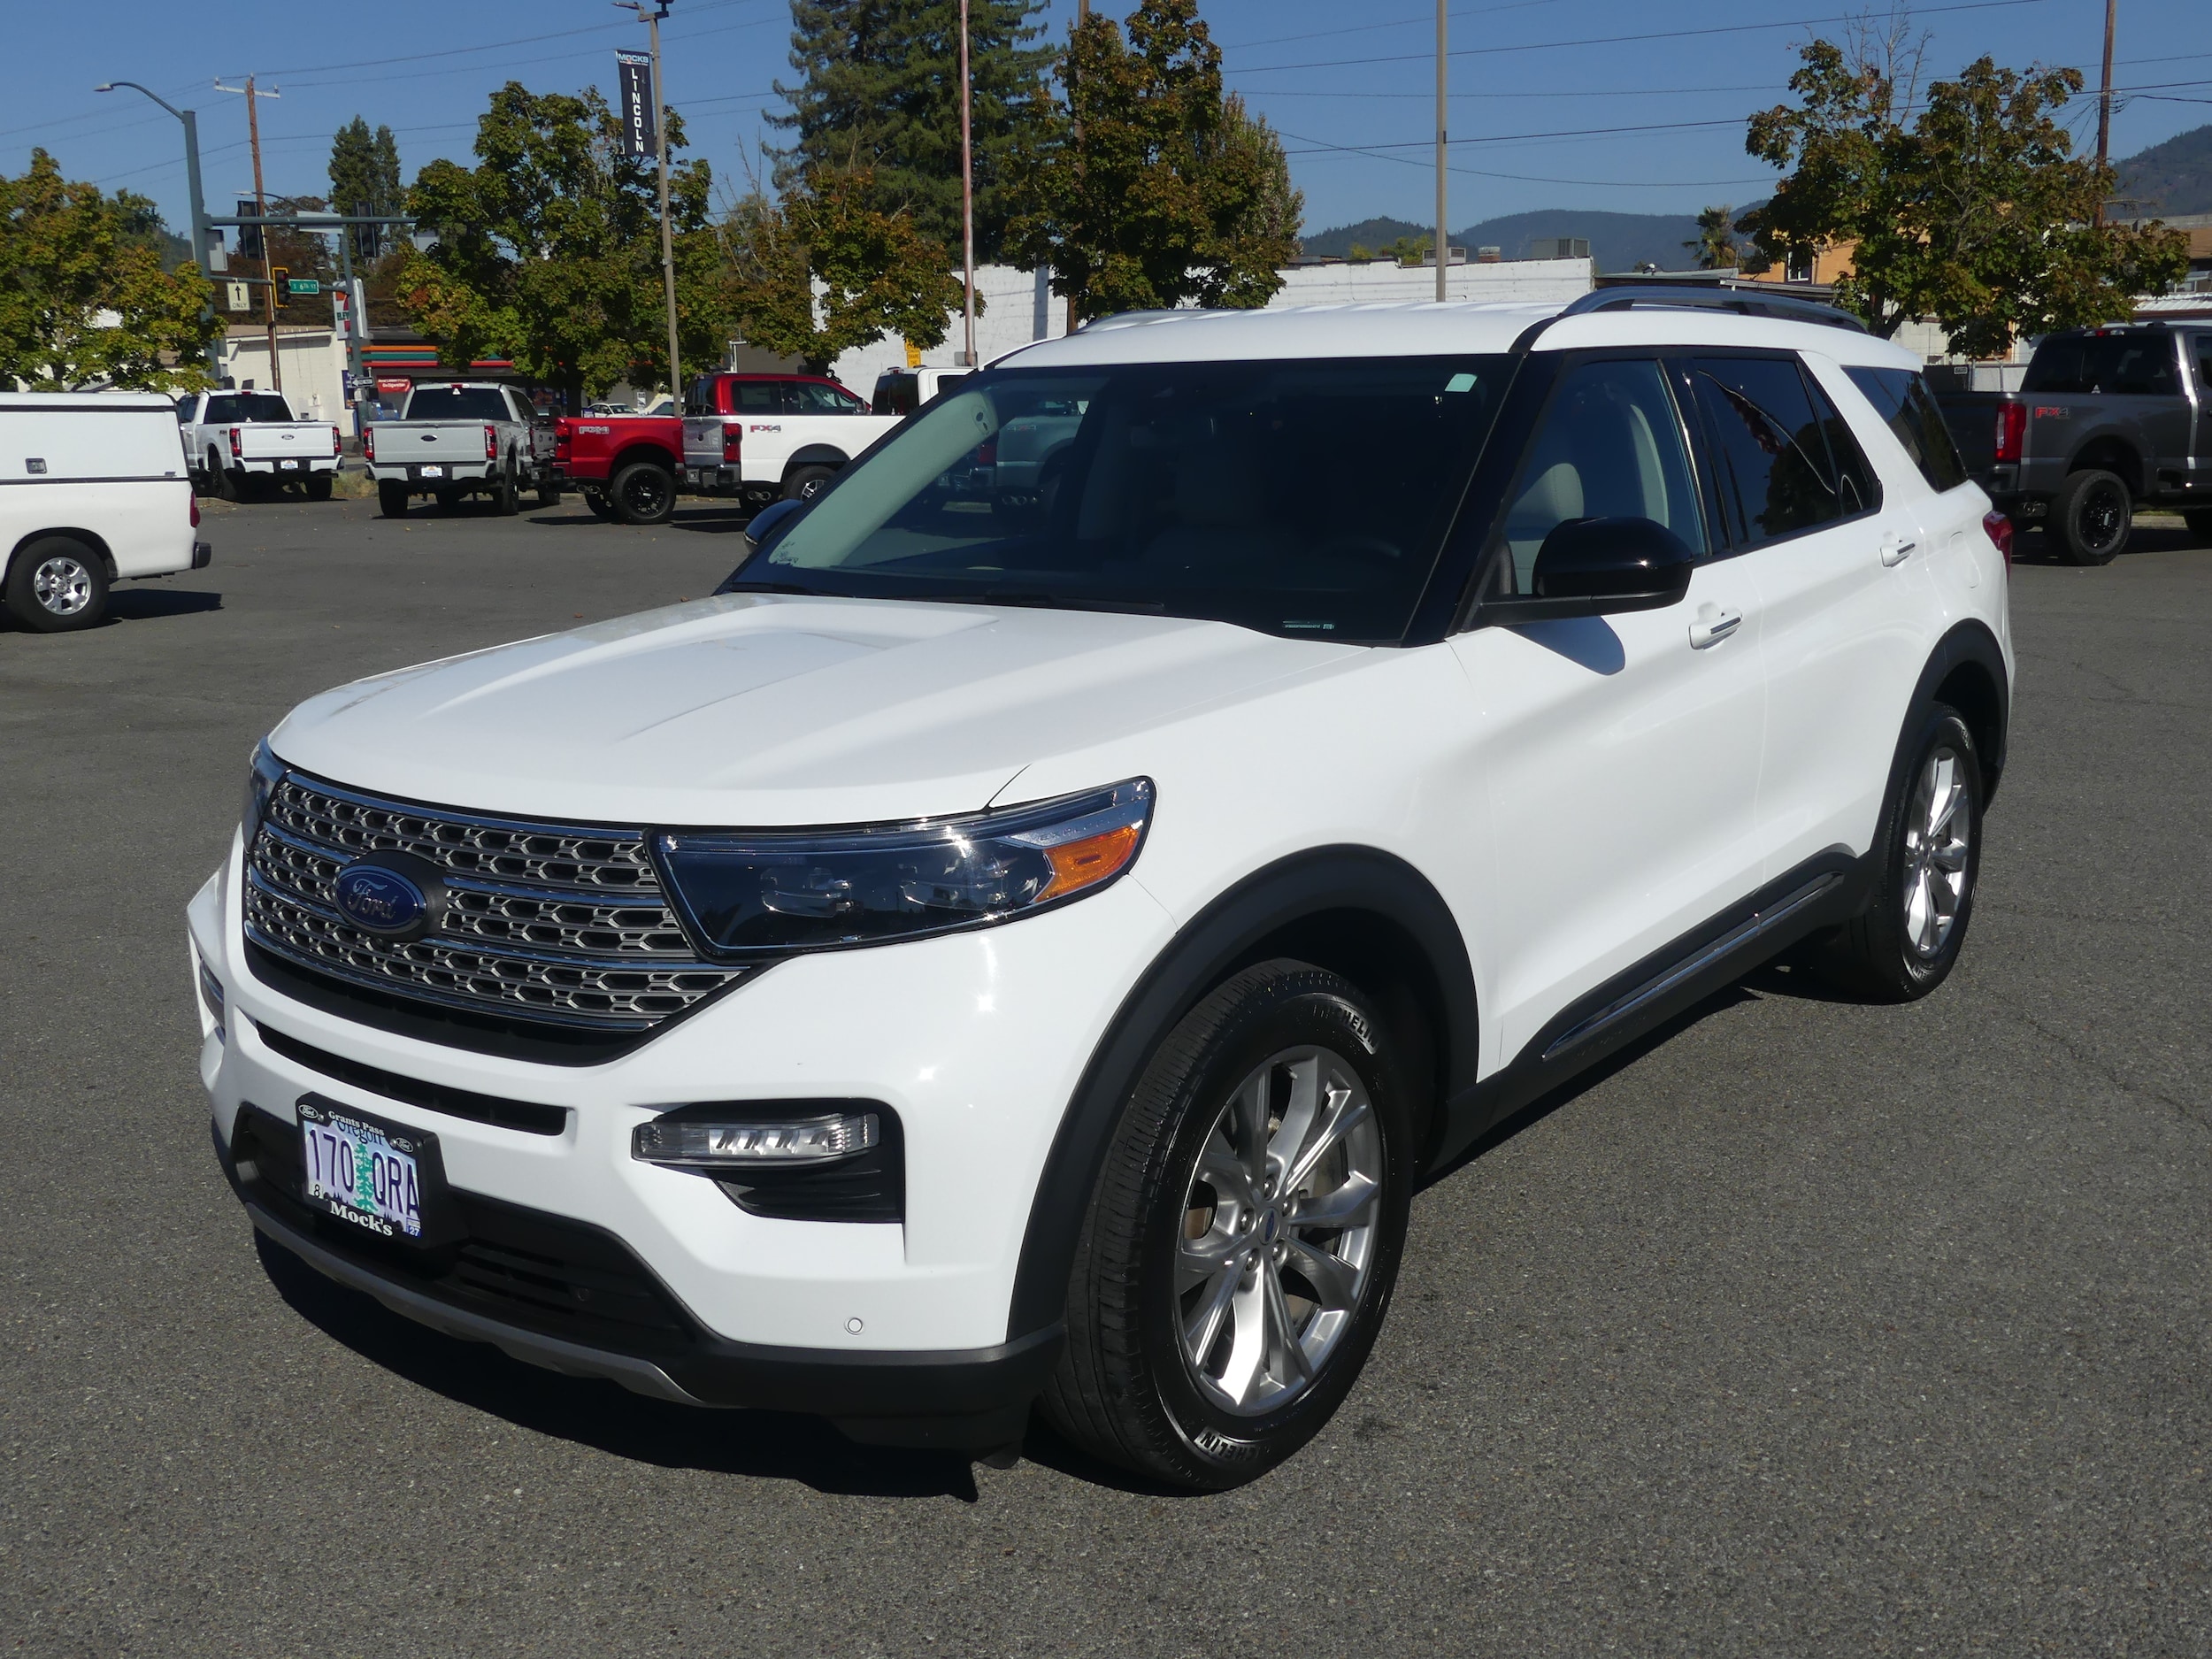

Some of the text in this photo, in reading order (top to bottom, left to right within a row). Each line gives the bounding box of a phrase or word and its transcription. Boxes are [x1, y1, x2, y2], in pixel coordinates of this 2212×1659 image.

[631, 67, 644, 152] LINCOLN
[2035, 406, 2070, 419] FX4
[579, 426, 610, 434] FX4
[749, 425, 781, 434] FX4
[328, 1110, 385, 1136] Grants Pass
[310, 1129, 420, 1217] 170 QRA
[314, 1184, 320, 1198] 8
[330, 1200, 394, 1237] Mock's
[409, 1225, 420, 1237] 27
[1200, 1431, 1262, 1463] ICHELIN
